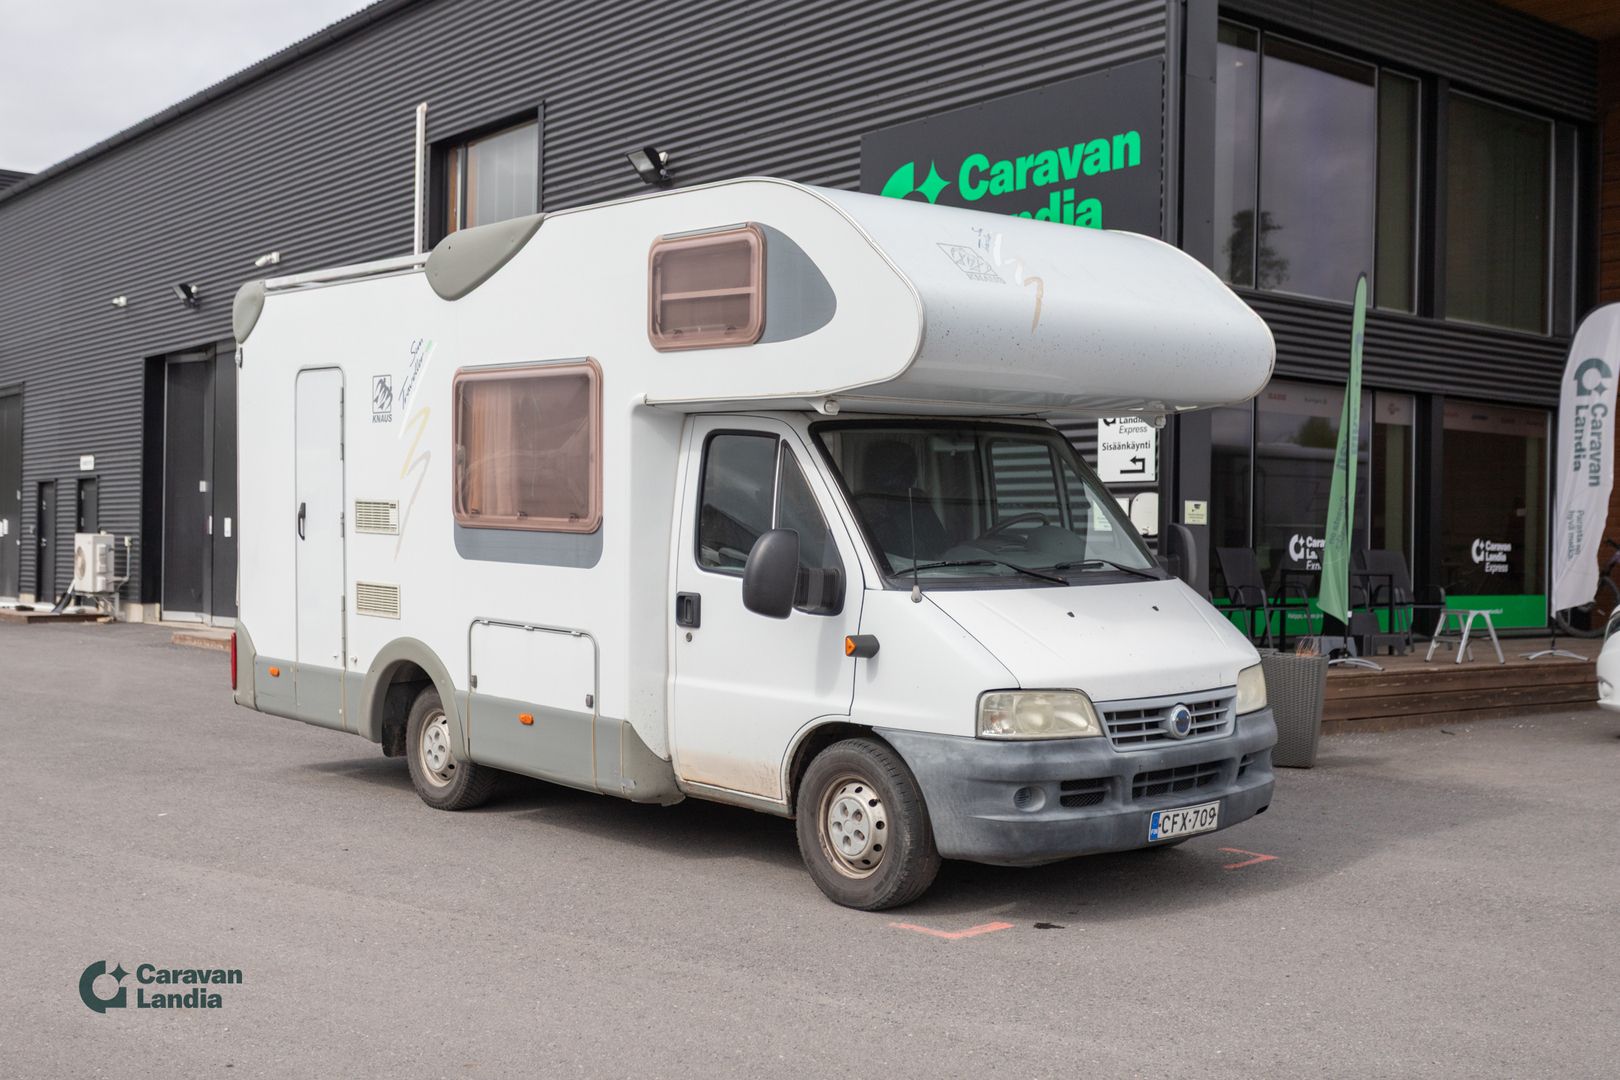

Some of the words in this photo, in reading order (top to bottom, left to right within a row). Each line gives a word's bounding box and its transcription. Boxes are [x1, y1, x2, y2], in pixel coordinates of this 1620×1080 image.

[957, 129, 1142, 202] Caravan
[371, 414, 393, 424] KNAUS
[1119, 425, 1148, 435] Express
[1573, 405, 1590, 473] Landia
[1588, 402, 1609, 488] Caravan
[1102, 440, 1151, 452] Sisäänkäynti
[1485, 540, 1512, 552] Caravan
[1485, 551, 1507, 562] Landia
[1485, 563, 1509, 575] Express
[1161, 807, 1216, 834] CFX-709
